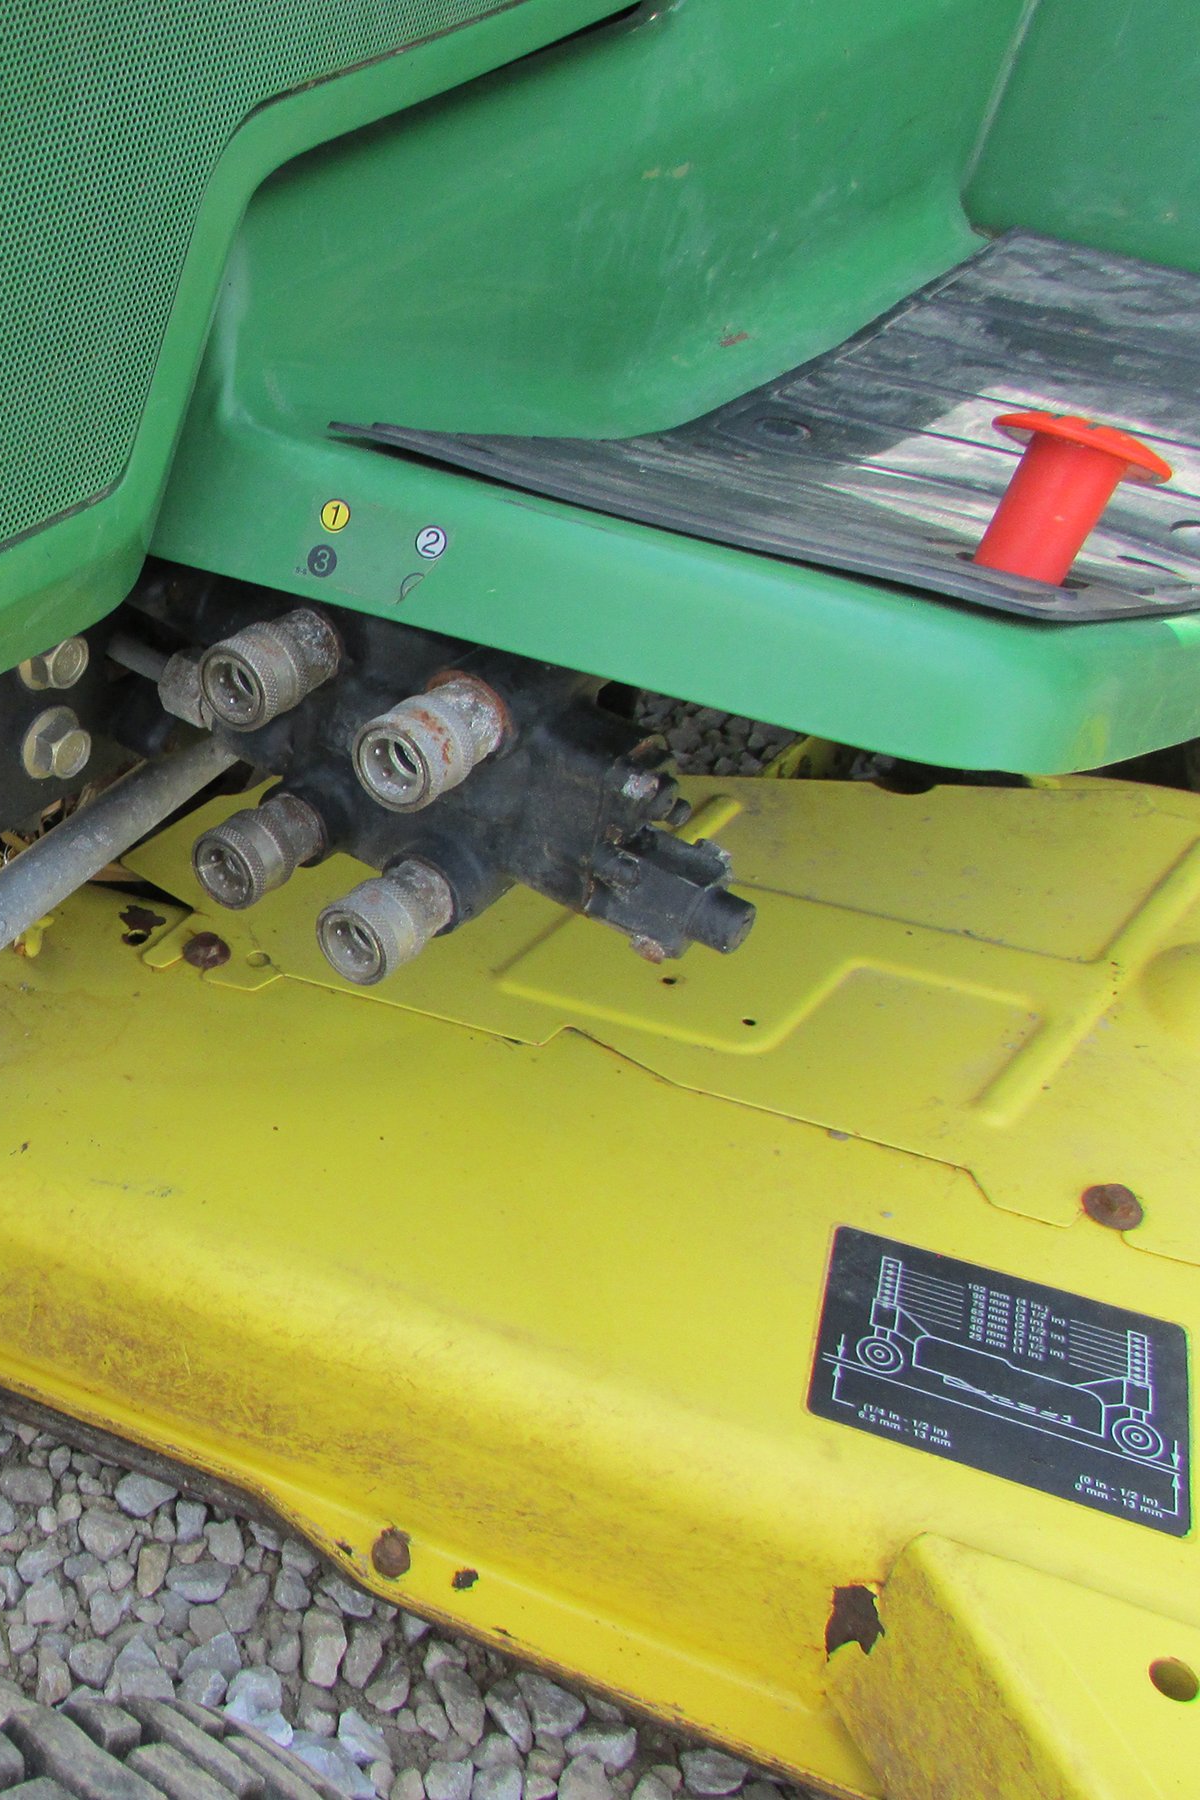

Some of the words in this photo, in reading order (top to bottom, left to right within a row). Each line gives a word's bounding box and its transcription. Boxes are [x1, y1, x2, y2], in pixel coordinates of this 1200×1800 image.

[331, 504, 340, 526] 1
[421, 530, 440, 555] 2
[314, 549, 330, 572] 3
[967, 1283, 986, 1293] 102
[989, 1290, 1010, 1300] mm
[972, 1300, 985, 1309] 75
[988, 1306, 1008, 1316] mm
[1029, 1317, 1044, 1328] in)
[989, 1298, 1009, 1308] mm
[1031, 1309, 1047, 1320] 1/2
[1051, 1315, 1066, 1326] in)
[987, 1313, 1008, 1324] mm
[1014, 1321, 1025, 1329] (2
[1030, 1326, 1046, 1336] 1/2
[1050, 1332, 1065, 1343] in)
[987, 1321, 1007, 1332] mm
[1014, 1329, 1025, 1337] (2
[1028, 1334, 1043, 1344] in)
[985, 1338, 1006, 1348] mm
[1012, 1345, 1022, 1354] (1
[1027, 1350, 1043, 1361] in)
[986, 1330, 1007, 1340] mm
[1013, 1337, 1023, 1345] (1
[1029, 1342, 1046, 1353] 1/2
[1049, 1349, 1064, 1359] in)
[858, 1410, 876, 1422] 6.5
[879, 1418, 900, 1430] mm
[913, 1429, 926, 1439] 13
[930, 1435, 951, 1447] mm
[889, 1410, 899, 1420] in
[912, 1419, 929, 1430] 1/2
[933, 1426, 948, 1438] in)
[1074, 1482, 1082, 1491] 0
[1086, 1487, 1108, 1500] mm
[1122, 1498, 1136, 1509] 13
[1140, 1505, 1163, 1518] mm
[1079, 1475, 1091, 1485] (0
[1095, 1479, 1106, 1489] in
[1120, 1488, 1137, 1500] 1/2
[1142, 1494, 1159, 1507] in)
